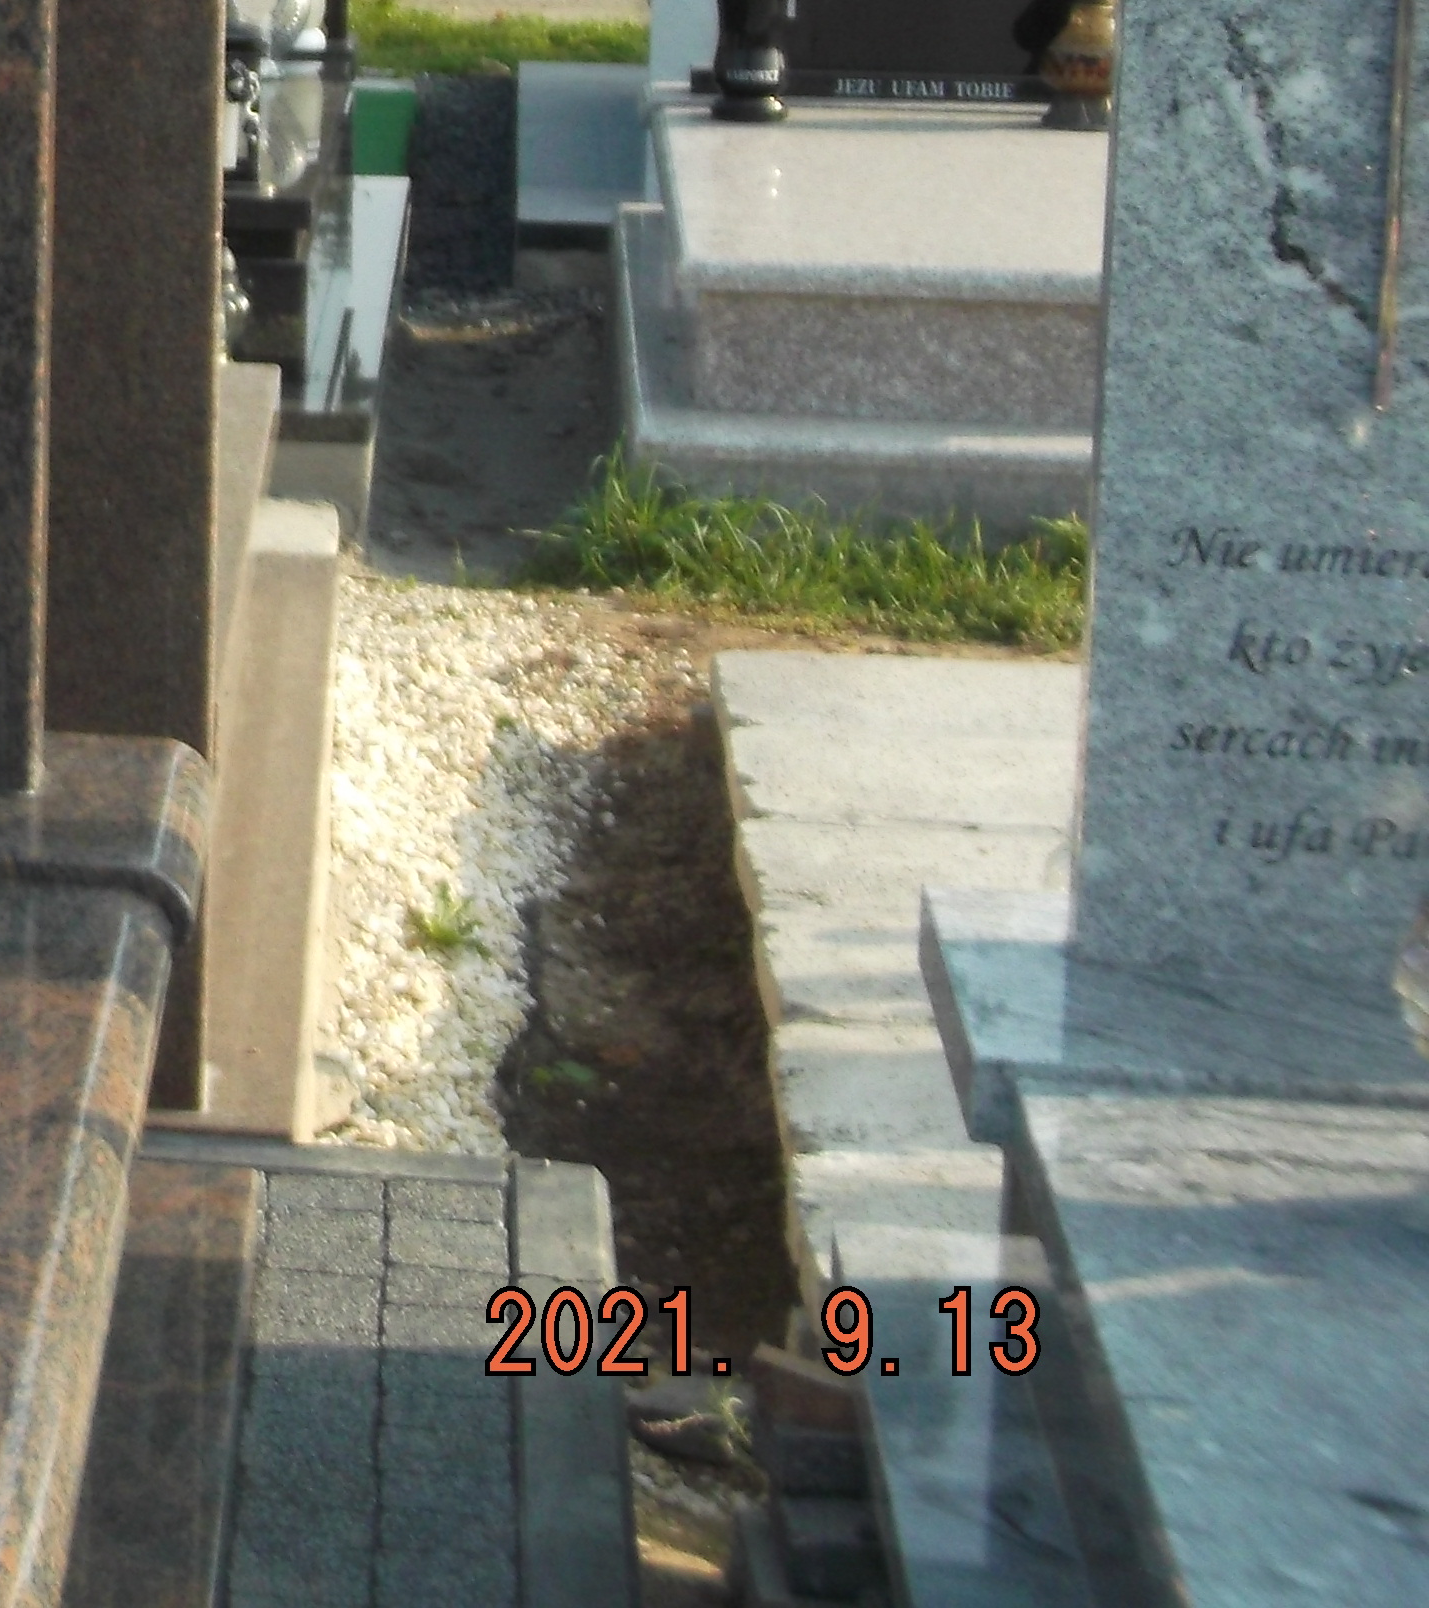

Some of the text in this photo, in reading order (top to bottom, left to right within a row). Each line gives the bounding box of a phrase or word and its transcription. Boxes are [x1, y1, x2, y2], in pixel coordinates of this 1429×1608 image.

[834, 77, 1015, 99] JEZU UFAM TOBIE
[1166, 525, 1262, 569] Nie
[1228, 614, 1313, 675] kto
[1170, 714, 1361, 763] sercach
[1250, 804, 1333, 865] ufa
